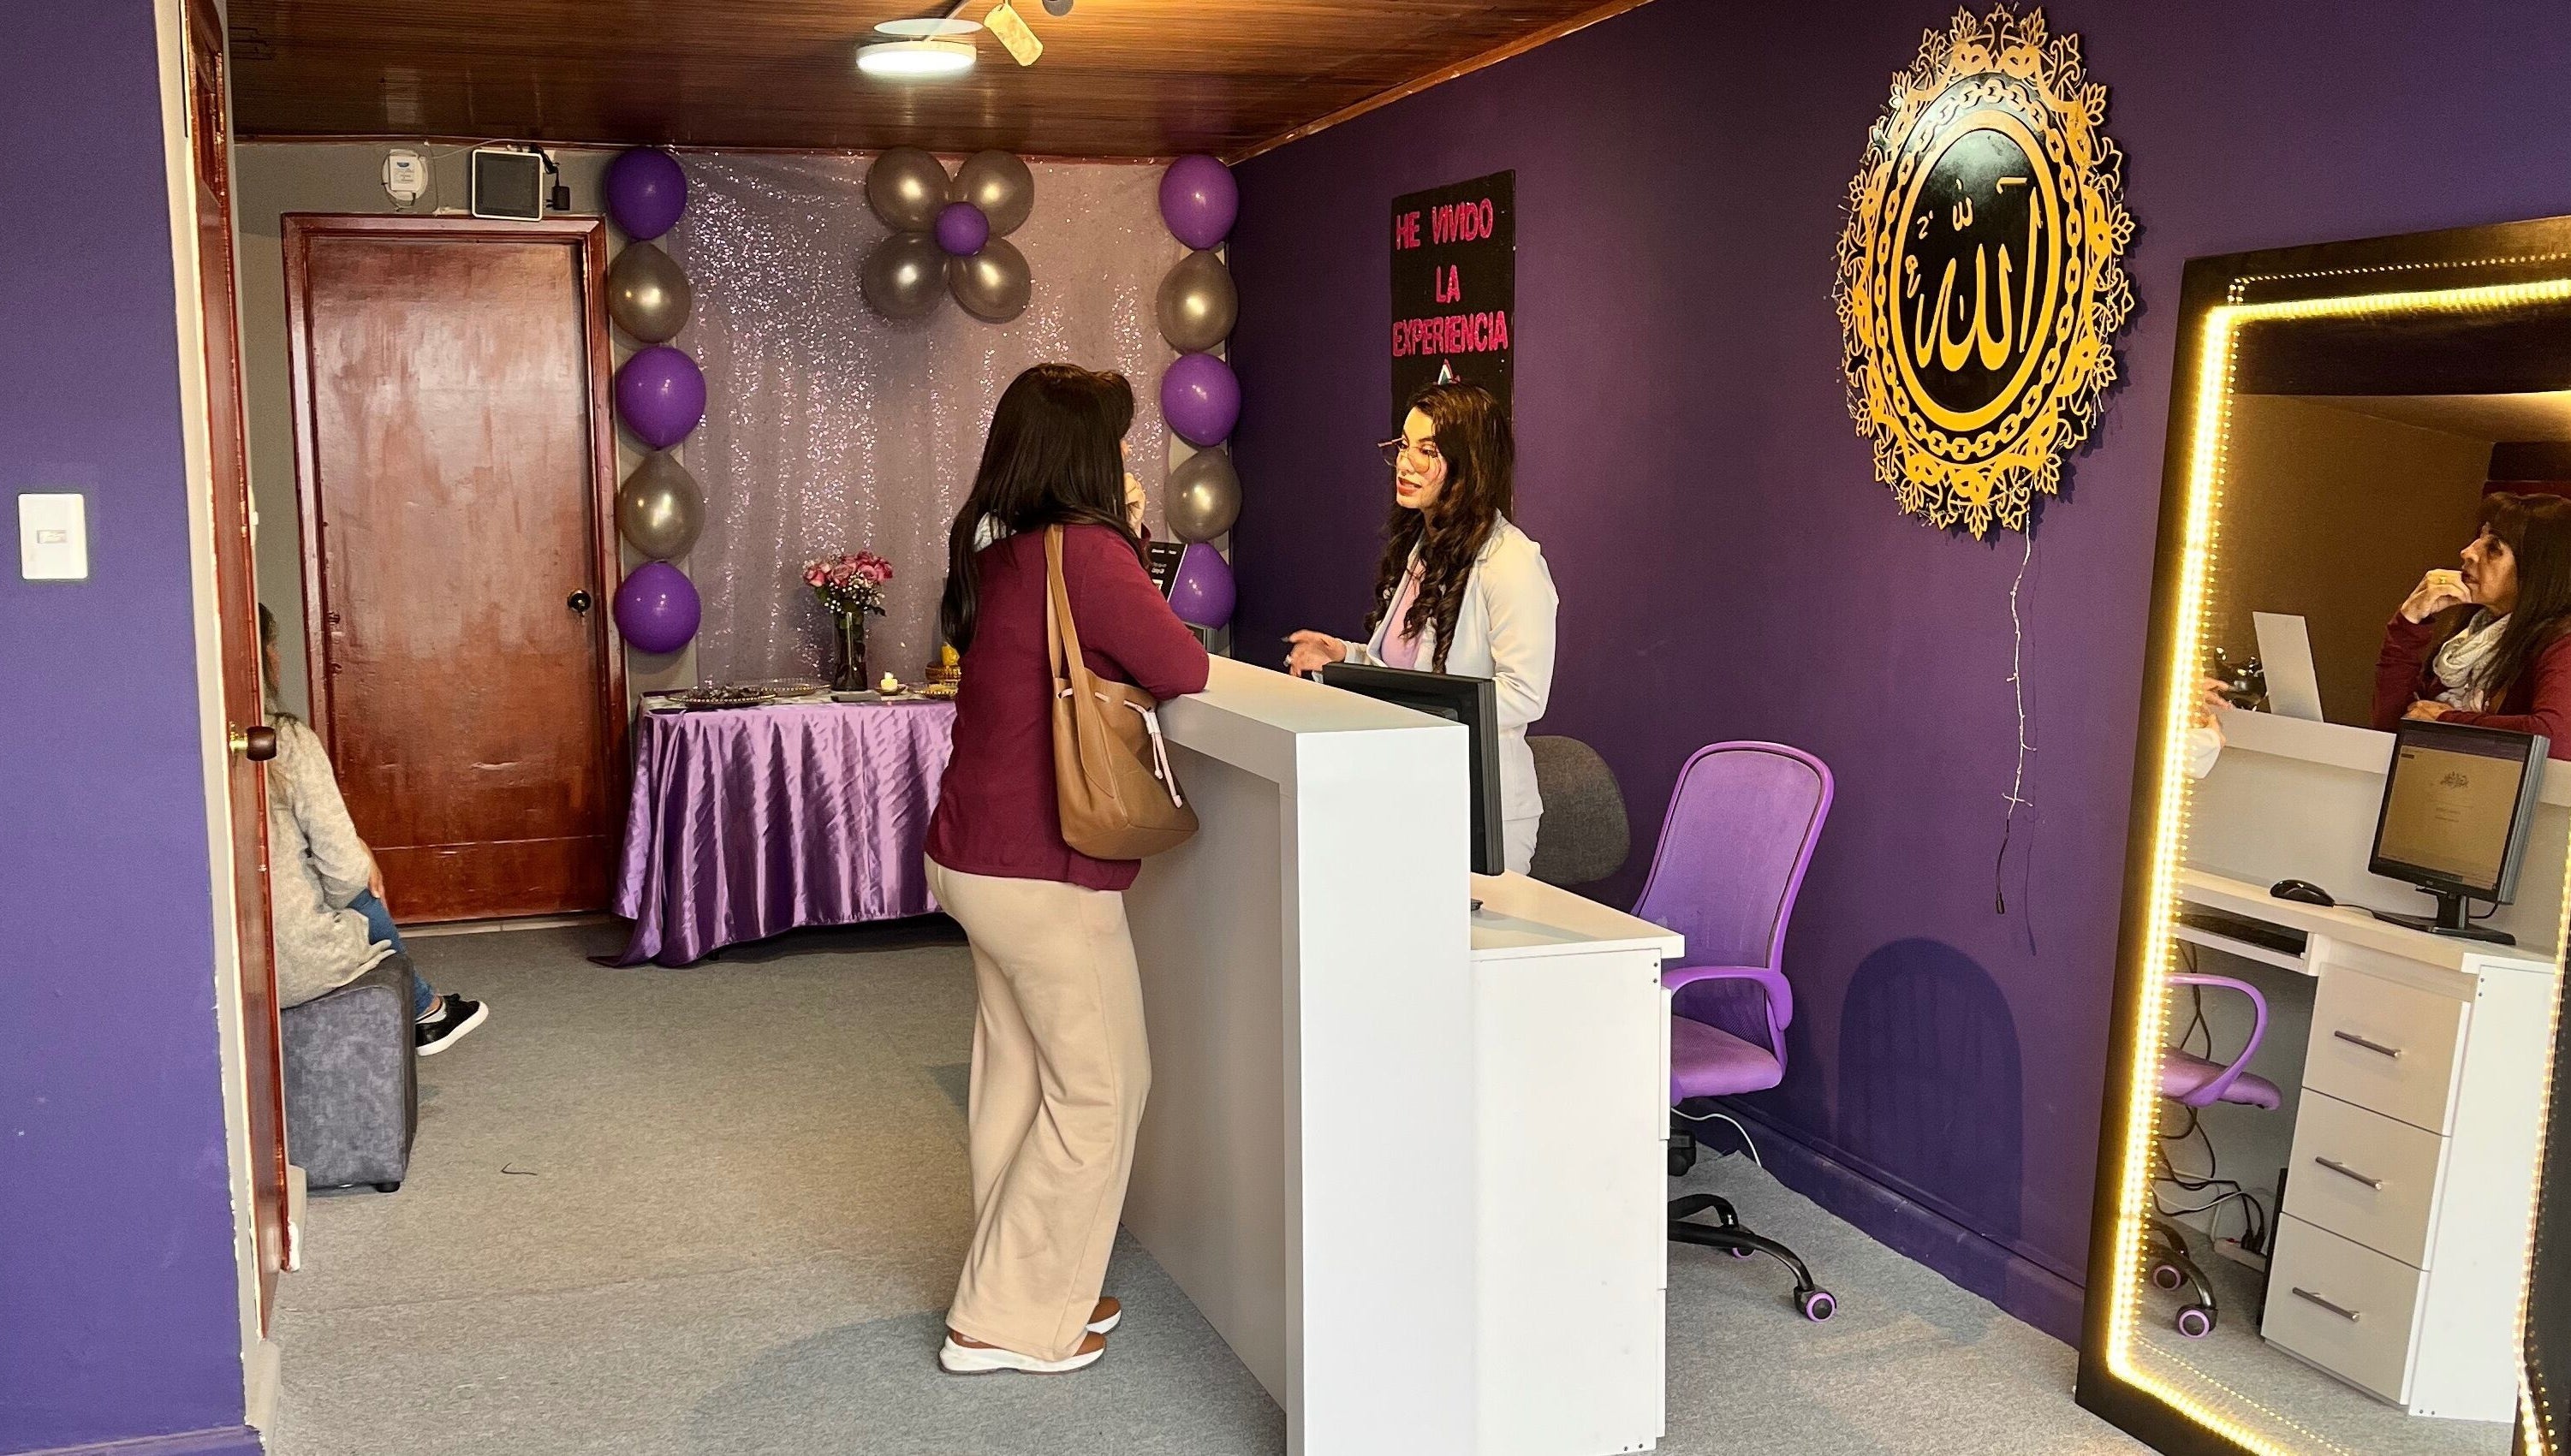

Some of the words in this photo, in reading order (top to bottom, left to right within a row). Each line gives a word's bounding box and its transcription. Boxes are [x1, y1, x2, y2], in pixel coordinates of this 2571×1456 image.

[1396, 211, 1421, 250] HE
[1431, 198, 1494, 245] VIVIDO
[1435, 264, 1461, 304] LA
[1392, 310, 1509, 357] EXPERIENCIA
